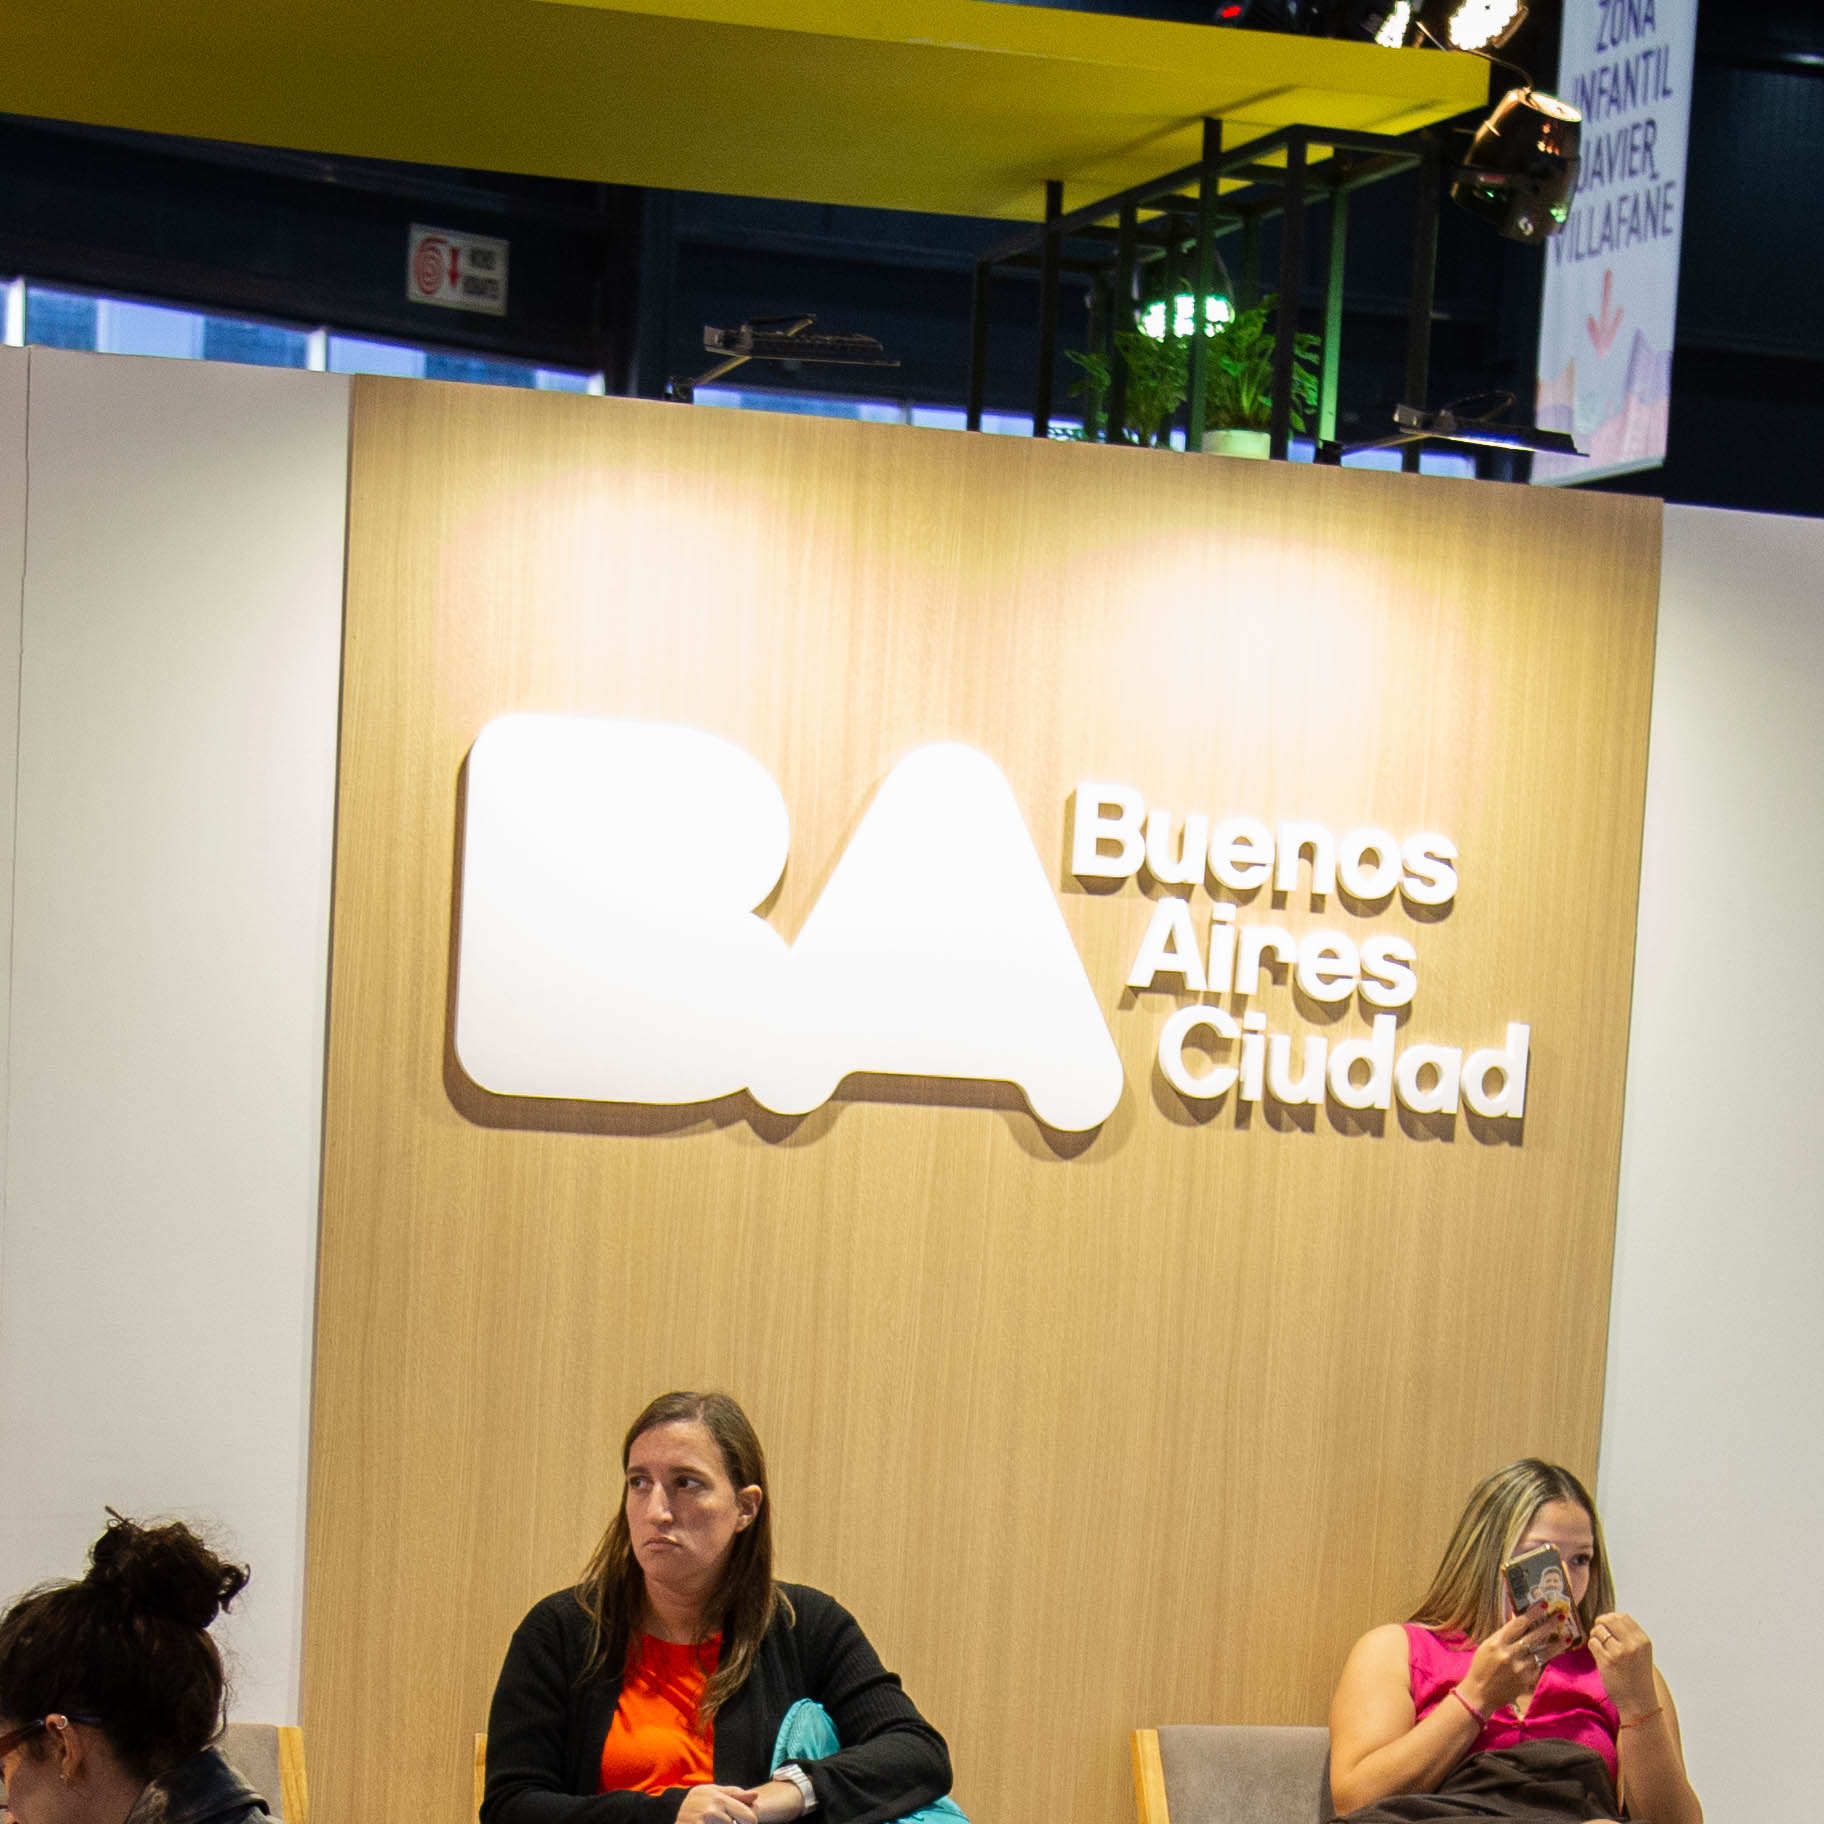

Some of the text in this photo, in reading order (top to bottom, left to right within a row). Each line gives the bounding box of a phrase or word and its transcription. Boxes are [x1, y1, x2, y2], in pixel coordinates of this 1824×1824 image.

[1596, 0, 1656, 52] ZONA
[1573, 44, 1674, 124] INFANTIL
[1576, 118, 1658, 193] JAVIER
[1070, 781, 1459, 907] Buenos
[456, 712, 1125, 1134] BA
[1127, 897, 1418, 1009] Aires
[1157, 1004, 1532, 1121] Ciudad
